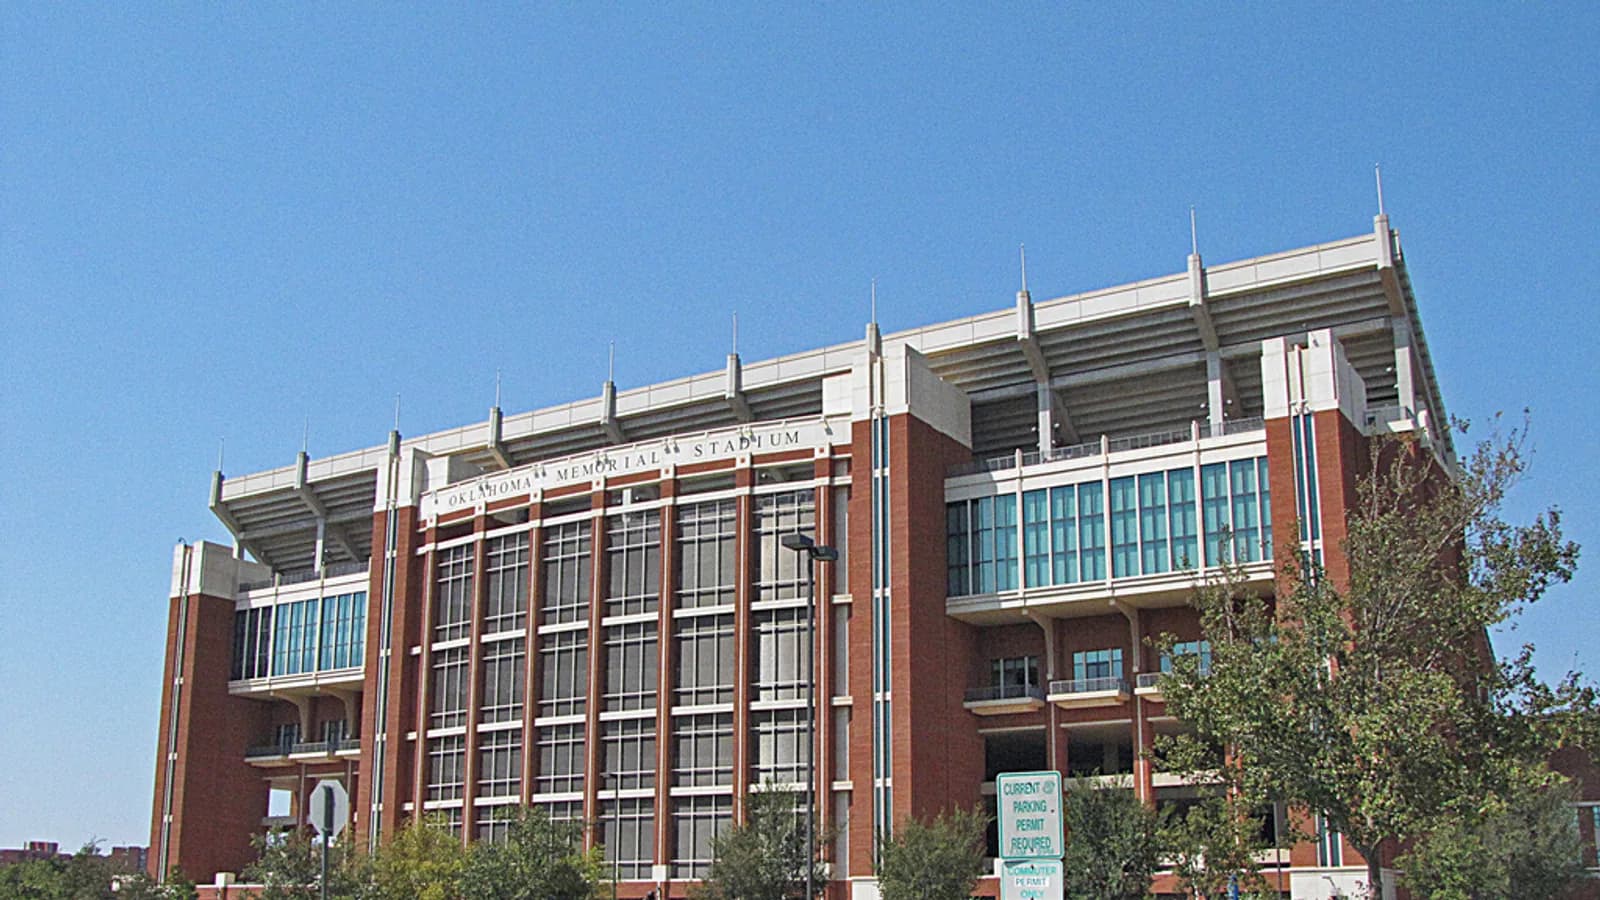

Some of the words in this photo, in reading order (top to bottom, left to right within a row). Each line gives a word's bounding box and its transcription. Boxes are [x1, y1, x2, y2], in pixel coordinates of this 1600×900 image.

[448, 477, 532, 507] OKLAHOMA
[556, 451, 660, 482] MEMORIAL
[694, 430, 800, 458] STADIUM
[1003, 782, 1041, 795] CURRENT
[1013, 800, 1047, 813] PARKING
[1016, 819, 1045, 831] PERMIT
[1011, 837, 1051, 850] REQUIRED
[1007, 867, 1057, 876] COMMUTER
[1016, 878, 1046, 887] PERMIT
[1020, 890, 1045, 899] ONLY
